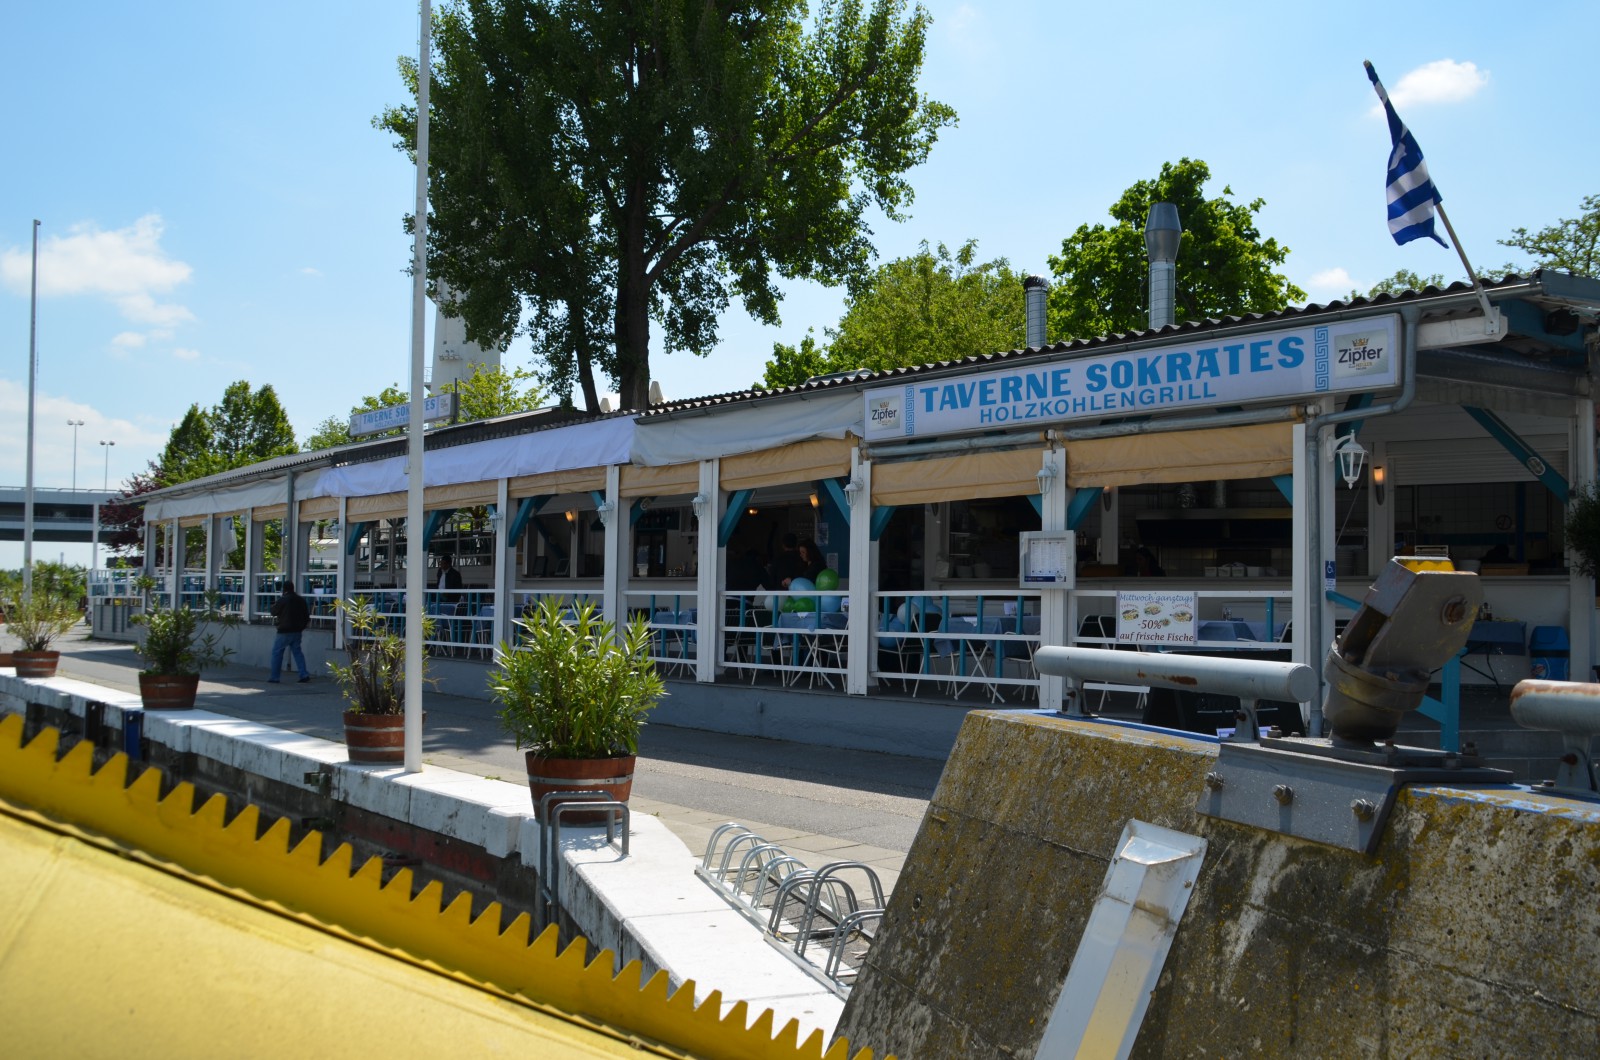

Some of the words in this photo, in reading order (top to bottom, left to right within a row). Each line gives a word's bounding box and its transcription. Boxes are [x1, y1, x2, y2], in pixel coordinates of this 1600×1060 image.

[1338, 346, 1383, 365] Zipfer
[920, 368, 1072, 413] TAVERNE
[1085, 336, 1305, 393] SOKRATES
[980, 381, 1217, 424] HOLZKOHLENGRILL
[363, 408, 393, 424] TAVERNE
[871, 407, 898, 422] Zipfer
[1120, 593, 1154, 602] Mittwoch
[1138, 619, 1162, 630] -50%
[1120, 631, 1135, 642] auf
[1135, 631, 1165, 642] frische
[1167, 632, 1194, 642] Fische
